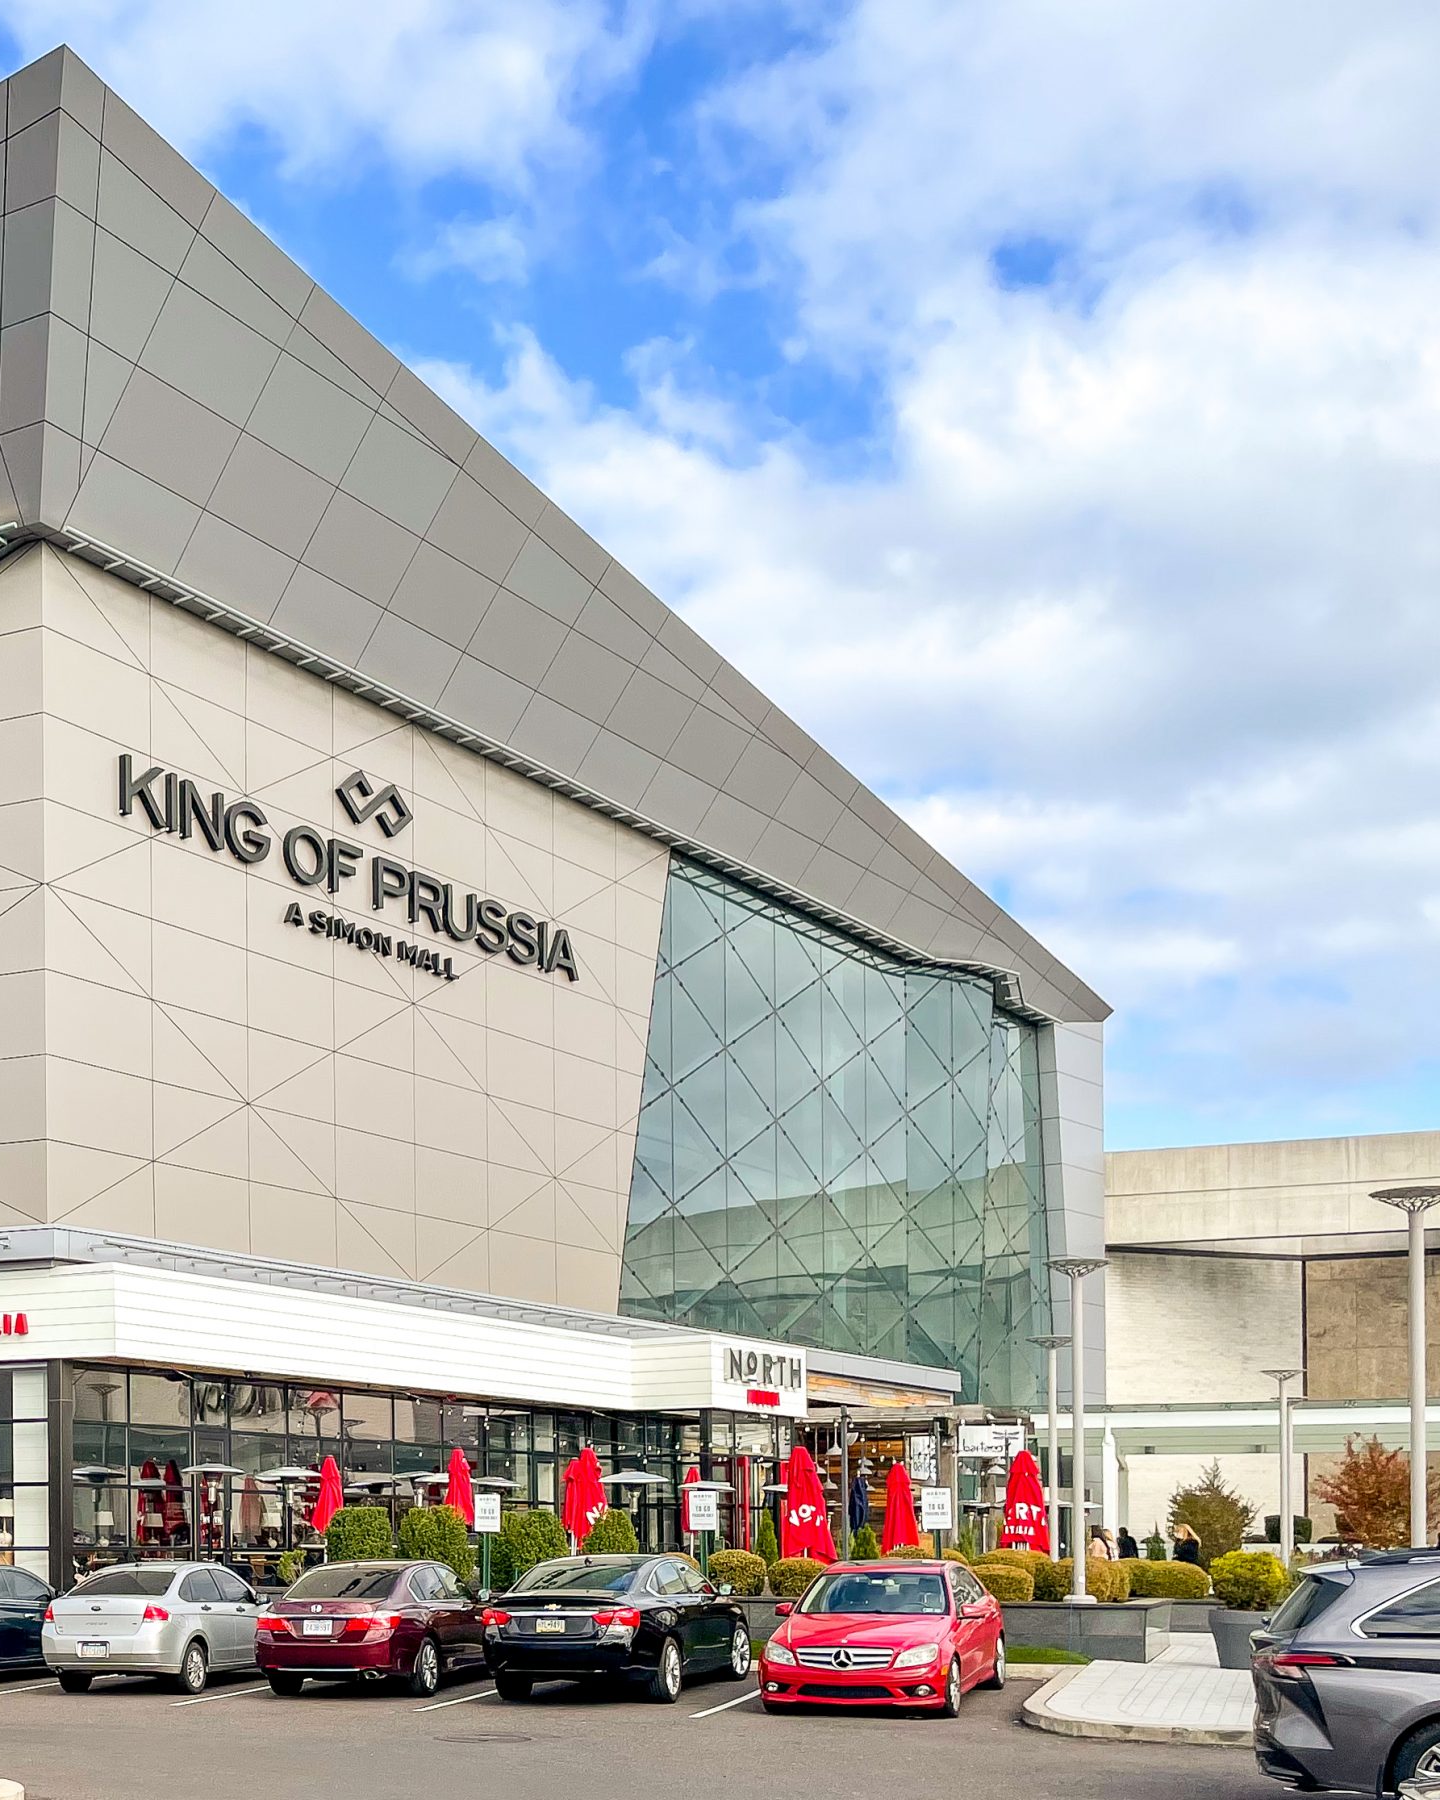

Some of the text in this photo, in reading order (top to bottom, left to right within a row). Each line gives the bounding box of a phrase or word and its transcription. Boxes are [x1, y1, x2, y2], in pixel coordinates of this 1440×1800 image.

[118, 753, 580, 983] KING OF PRUSSIA
[284, 902, 460, 981] A SIMON MALL
[723, 1348, 802, 1389] NORTH
[1004, 1525, 1035, 1536] ITALIA
